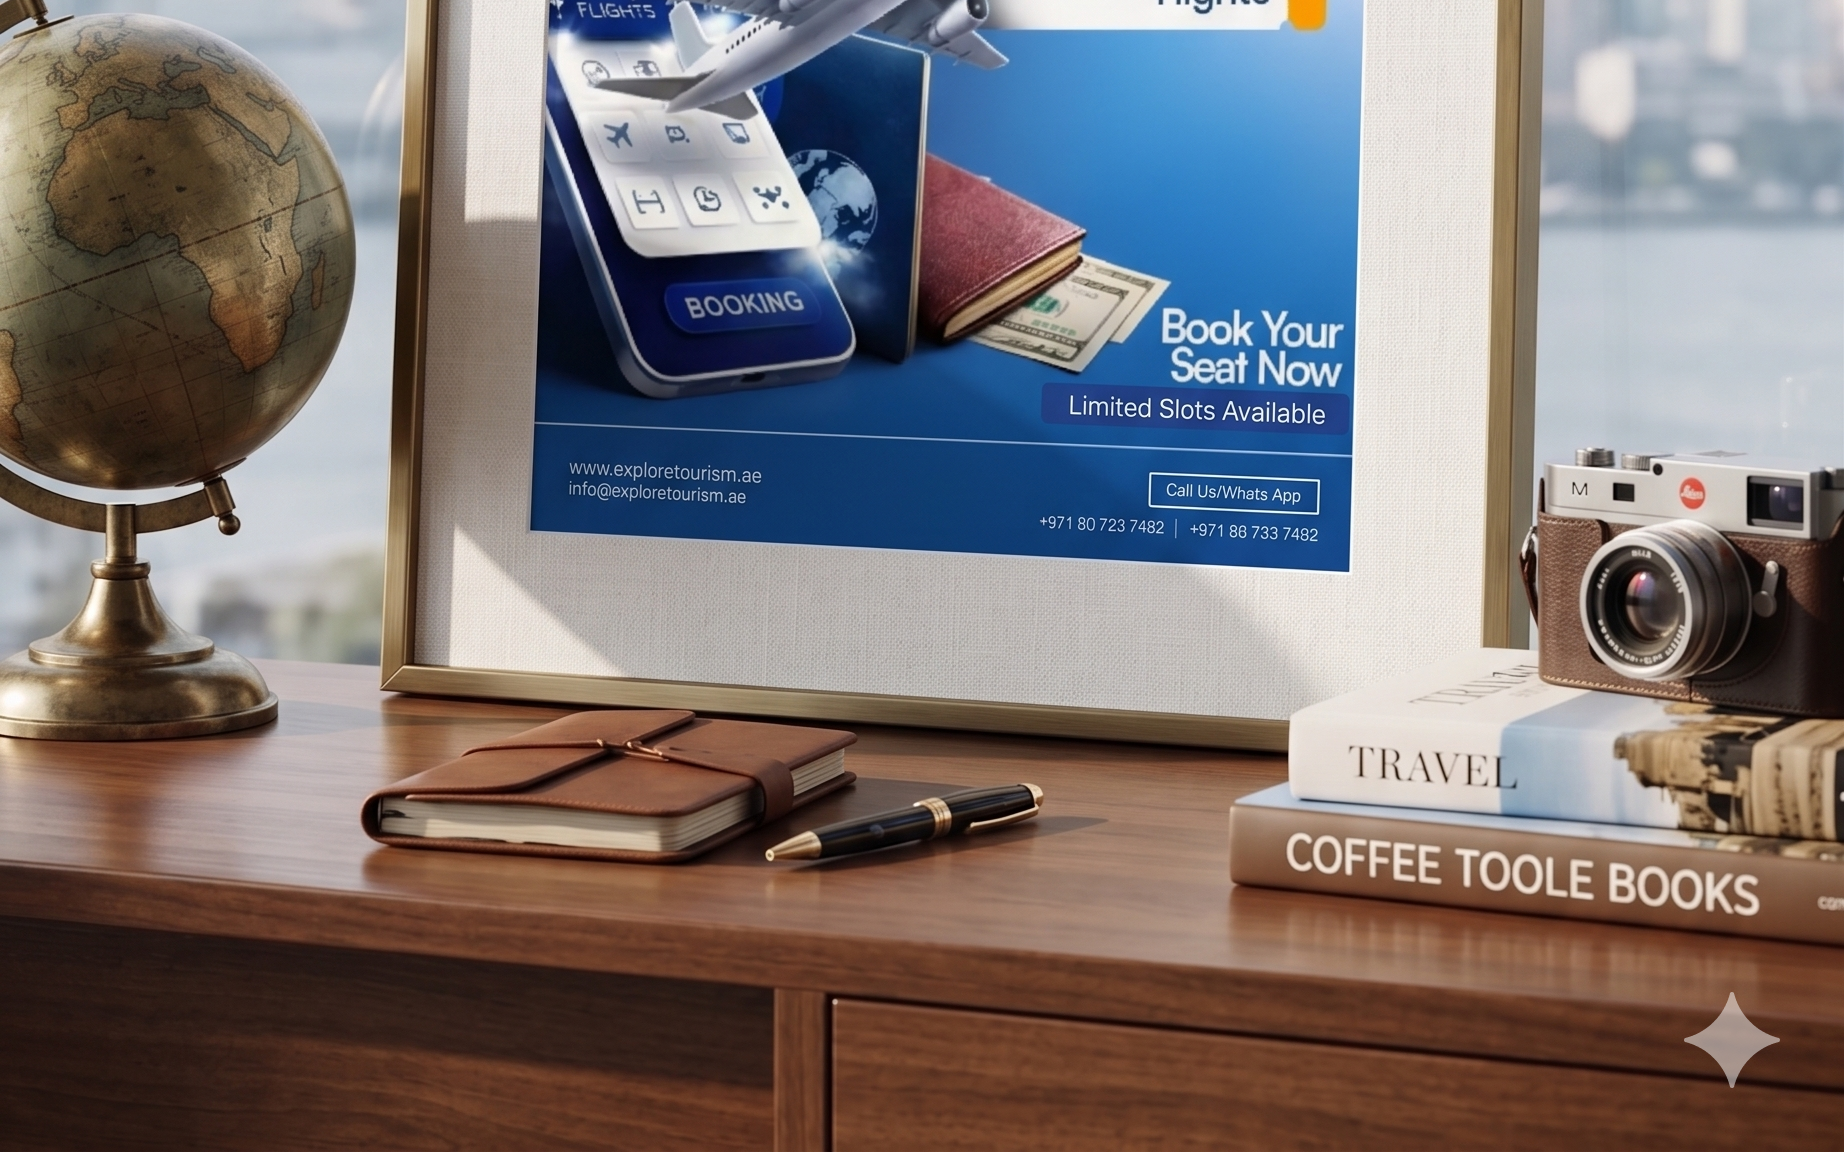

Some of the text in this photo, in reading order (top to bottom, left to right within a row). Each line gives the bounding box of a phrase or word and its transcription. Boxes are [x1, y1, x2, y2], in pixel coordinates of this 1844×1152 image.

[577, 1, 656, 19] FLIGHTS
[684, 290, 805, 320] BOOKING
[1161, 307, 1344, 349] Book Your
[1170, 346, 1343, 388] Seat Now
[1069, 395, 1326, 425] Limited Slots Available
[569, 462, 762, 484] www.exploretourism.ae
[568, 481, 747, 504] info@exploretourism.ae
[1165, 483, 1301, 504] Call Us/Whats App
[1571, 481, 1588, 496] M
[1039, 516, 1165, 535] +971 80 723 7482
[1190, 523, 1224, 538] +971
[1251, 526, 1279, 540] 733
[1283, 527, 1319, 542] 7482
[1349, 745, 1518, 789] TRAVEL
[1286, 832, 1760, 917] COFFEE TOOLE BOOKS
